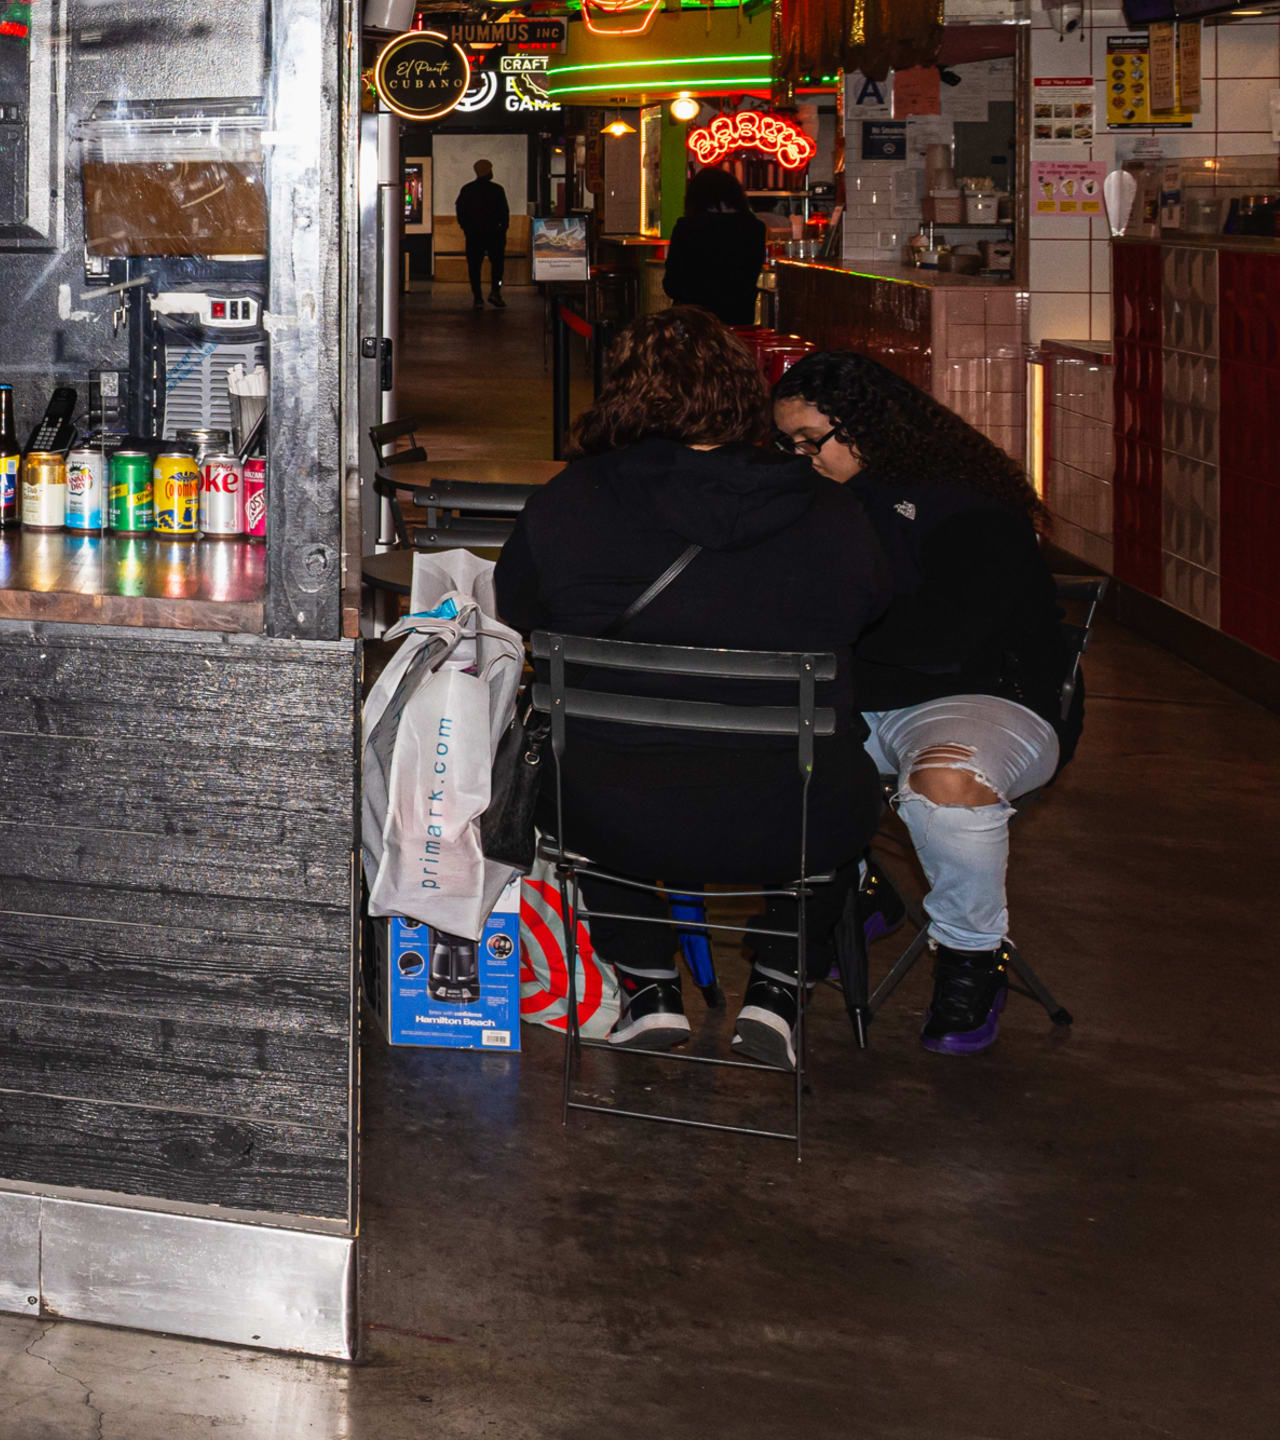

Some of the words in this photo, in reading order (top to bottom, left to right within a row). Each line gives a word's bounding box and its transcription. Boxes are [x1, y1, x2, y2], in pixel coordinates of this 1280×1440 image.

[451, 24, 529, 42] HUMMUS
[396, 59, 415, 78] El
[503, 57, 548, 72] CRAFT
[389, 78, 463, 89] CUBANO
[856, 78, 885, 105] A
[213, 462, 233, 472] Diet
[419, 717, 453, 890] primark.com
[415, 1015, 462, 1026] Hamilton
[463, 1017, 496, 1027] Beach
